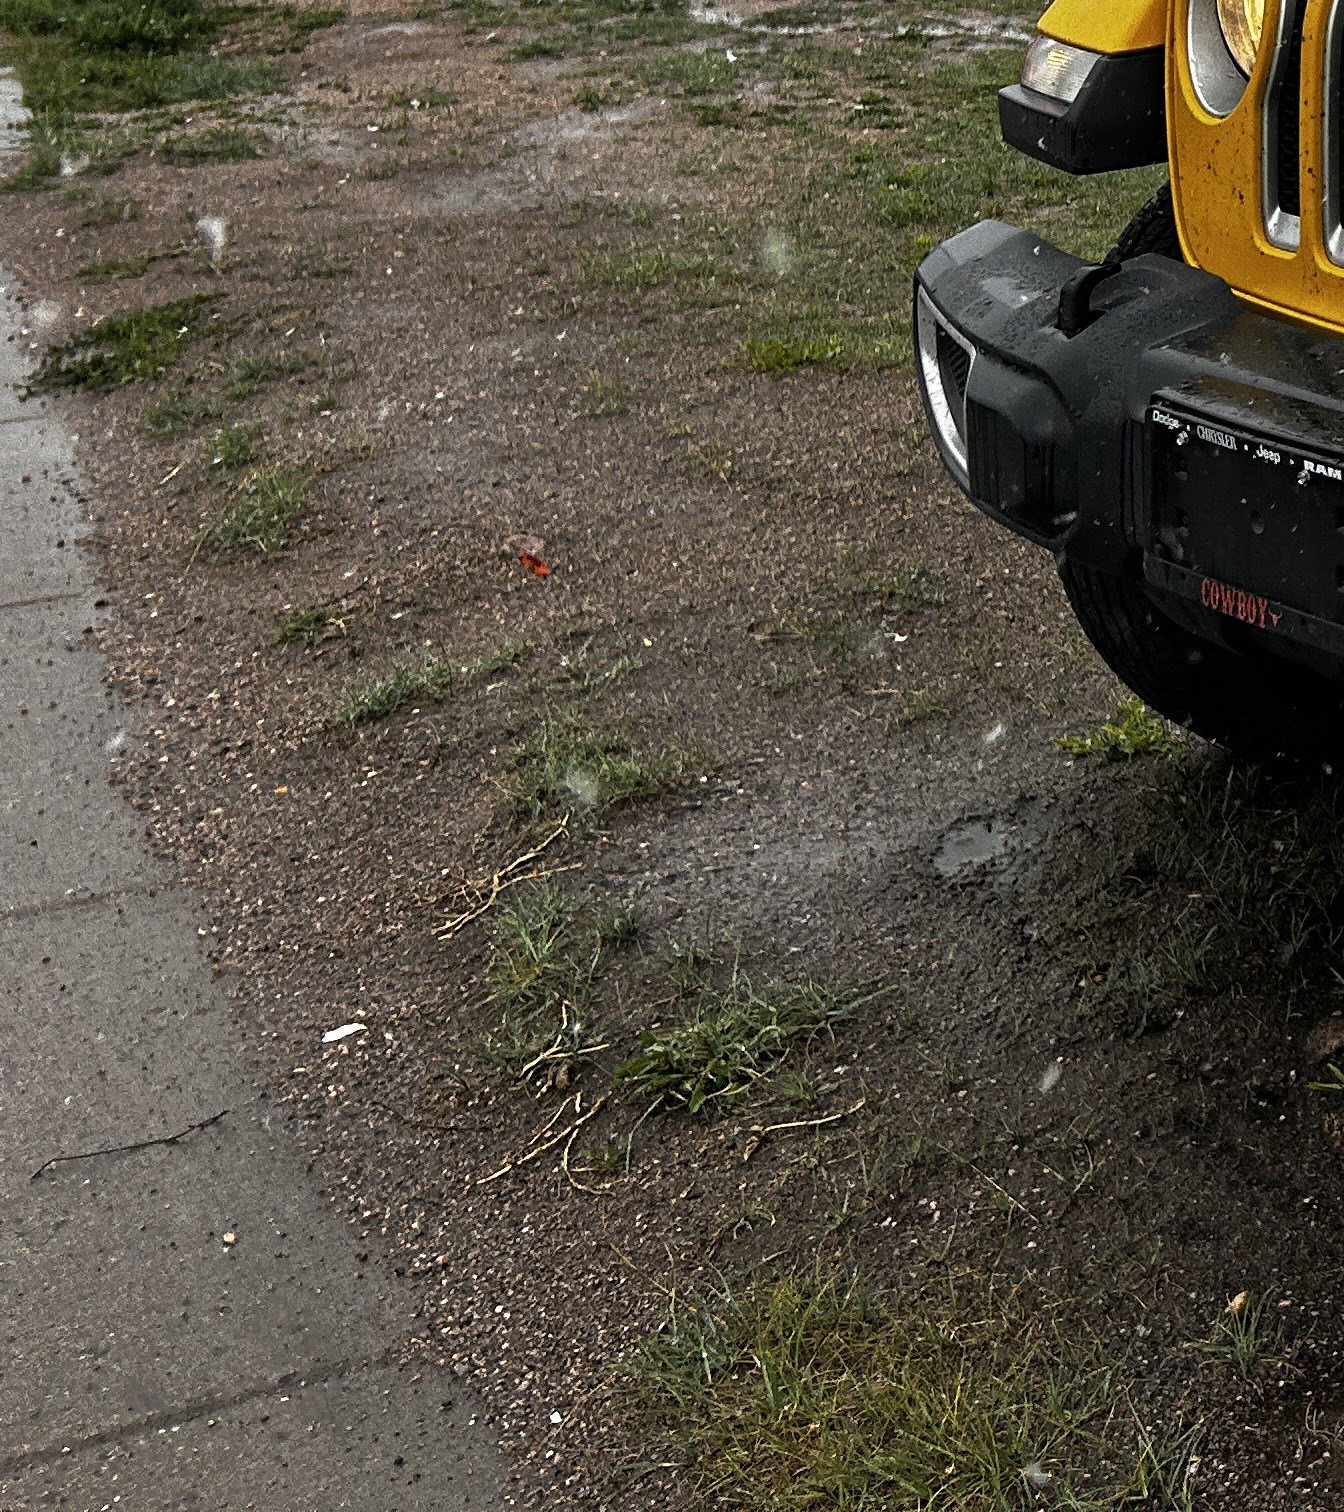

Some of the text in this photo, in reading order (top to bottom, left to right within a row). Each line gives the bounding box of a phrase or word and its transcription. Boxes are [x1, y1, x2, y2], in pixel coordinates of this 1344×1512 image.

[1196, 424, 1238, 451] CHRYSLER
[1255, 443, 1281, 465] Jeep
[1303, 459, 1343, 481] RAM
[1201, 577, 1268, 629] COWBOY
